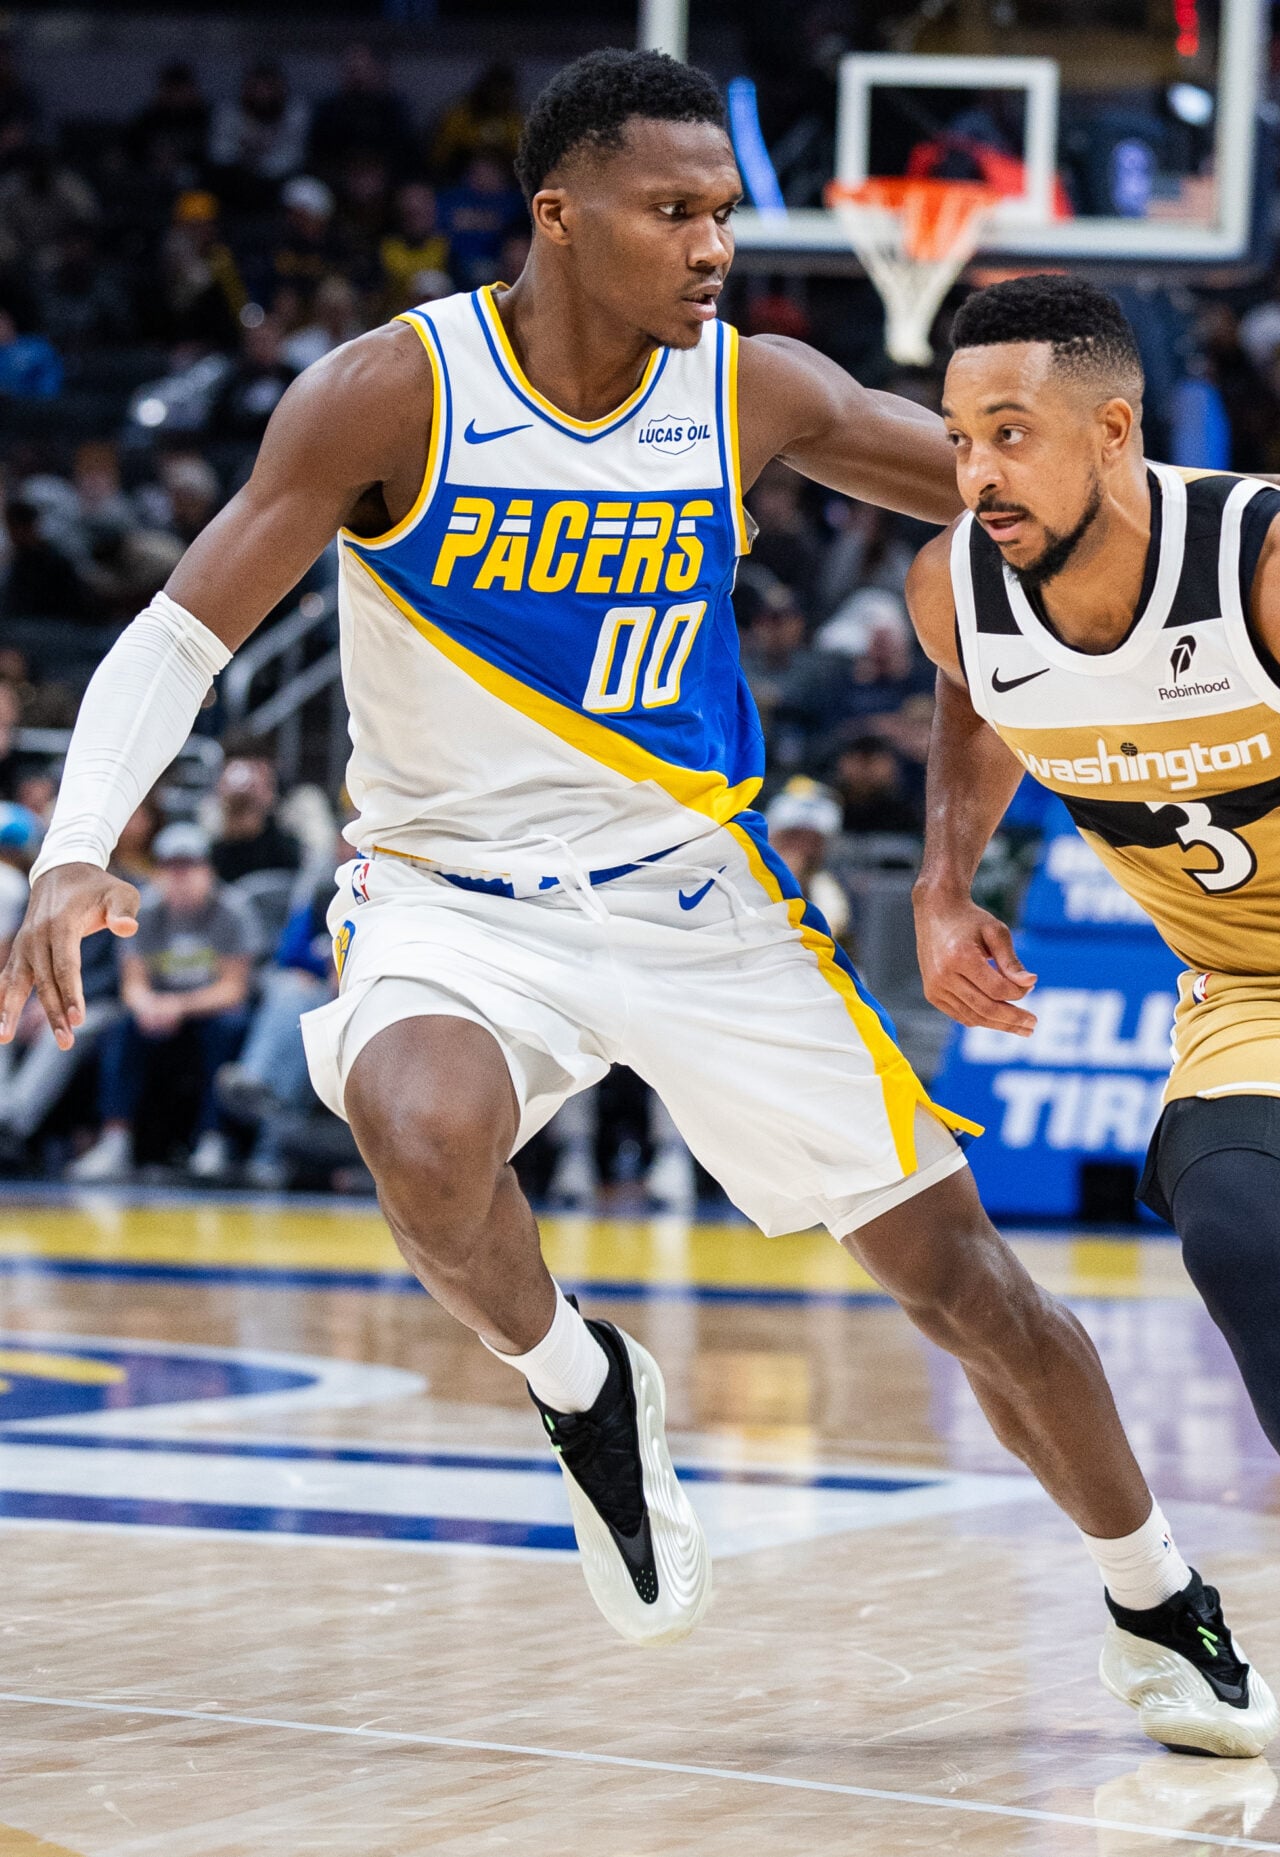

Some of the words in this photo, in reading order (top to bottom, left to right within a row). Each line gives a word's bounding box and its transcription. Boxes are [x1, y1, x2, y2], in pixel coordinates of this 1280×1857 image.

[638, 427, 683, 444] LUCAS
[687, 424, 711, 441] OIL
[431, 496, 714, 594] PACERS
[582, 600, 707, 714] 00
[1158, 677, 1231, 701] Robinhood
[1016, 732, 1272, 791] washington
[1143, 800, 1258, 894] 3
